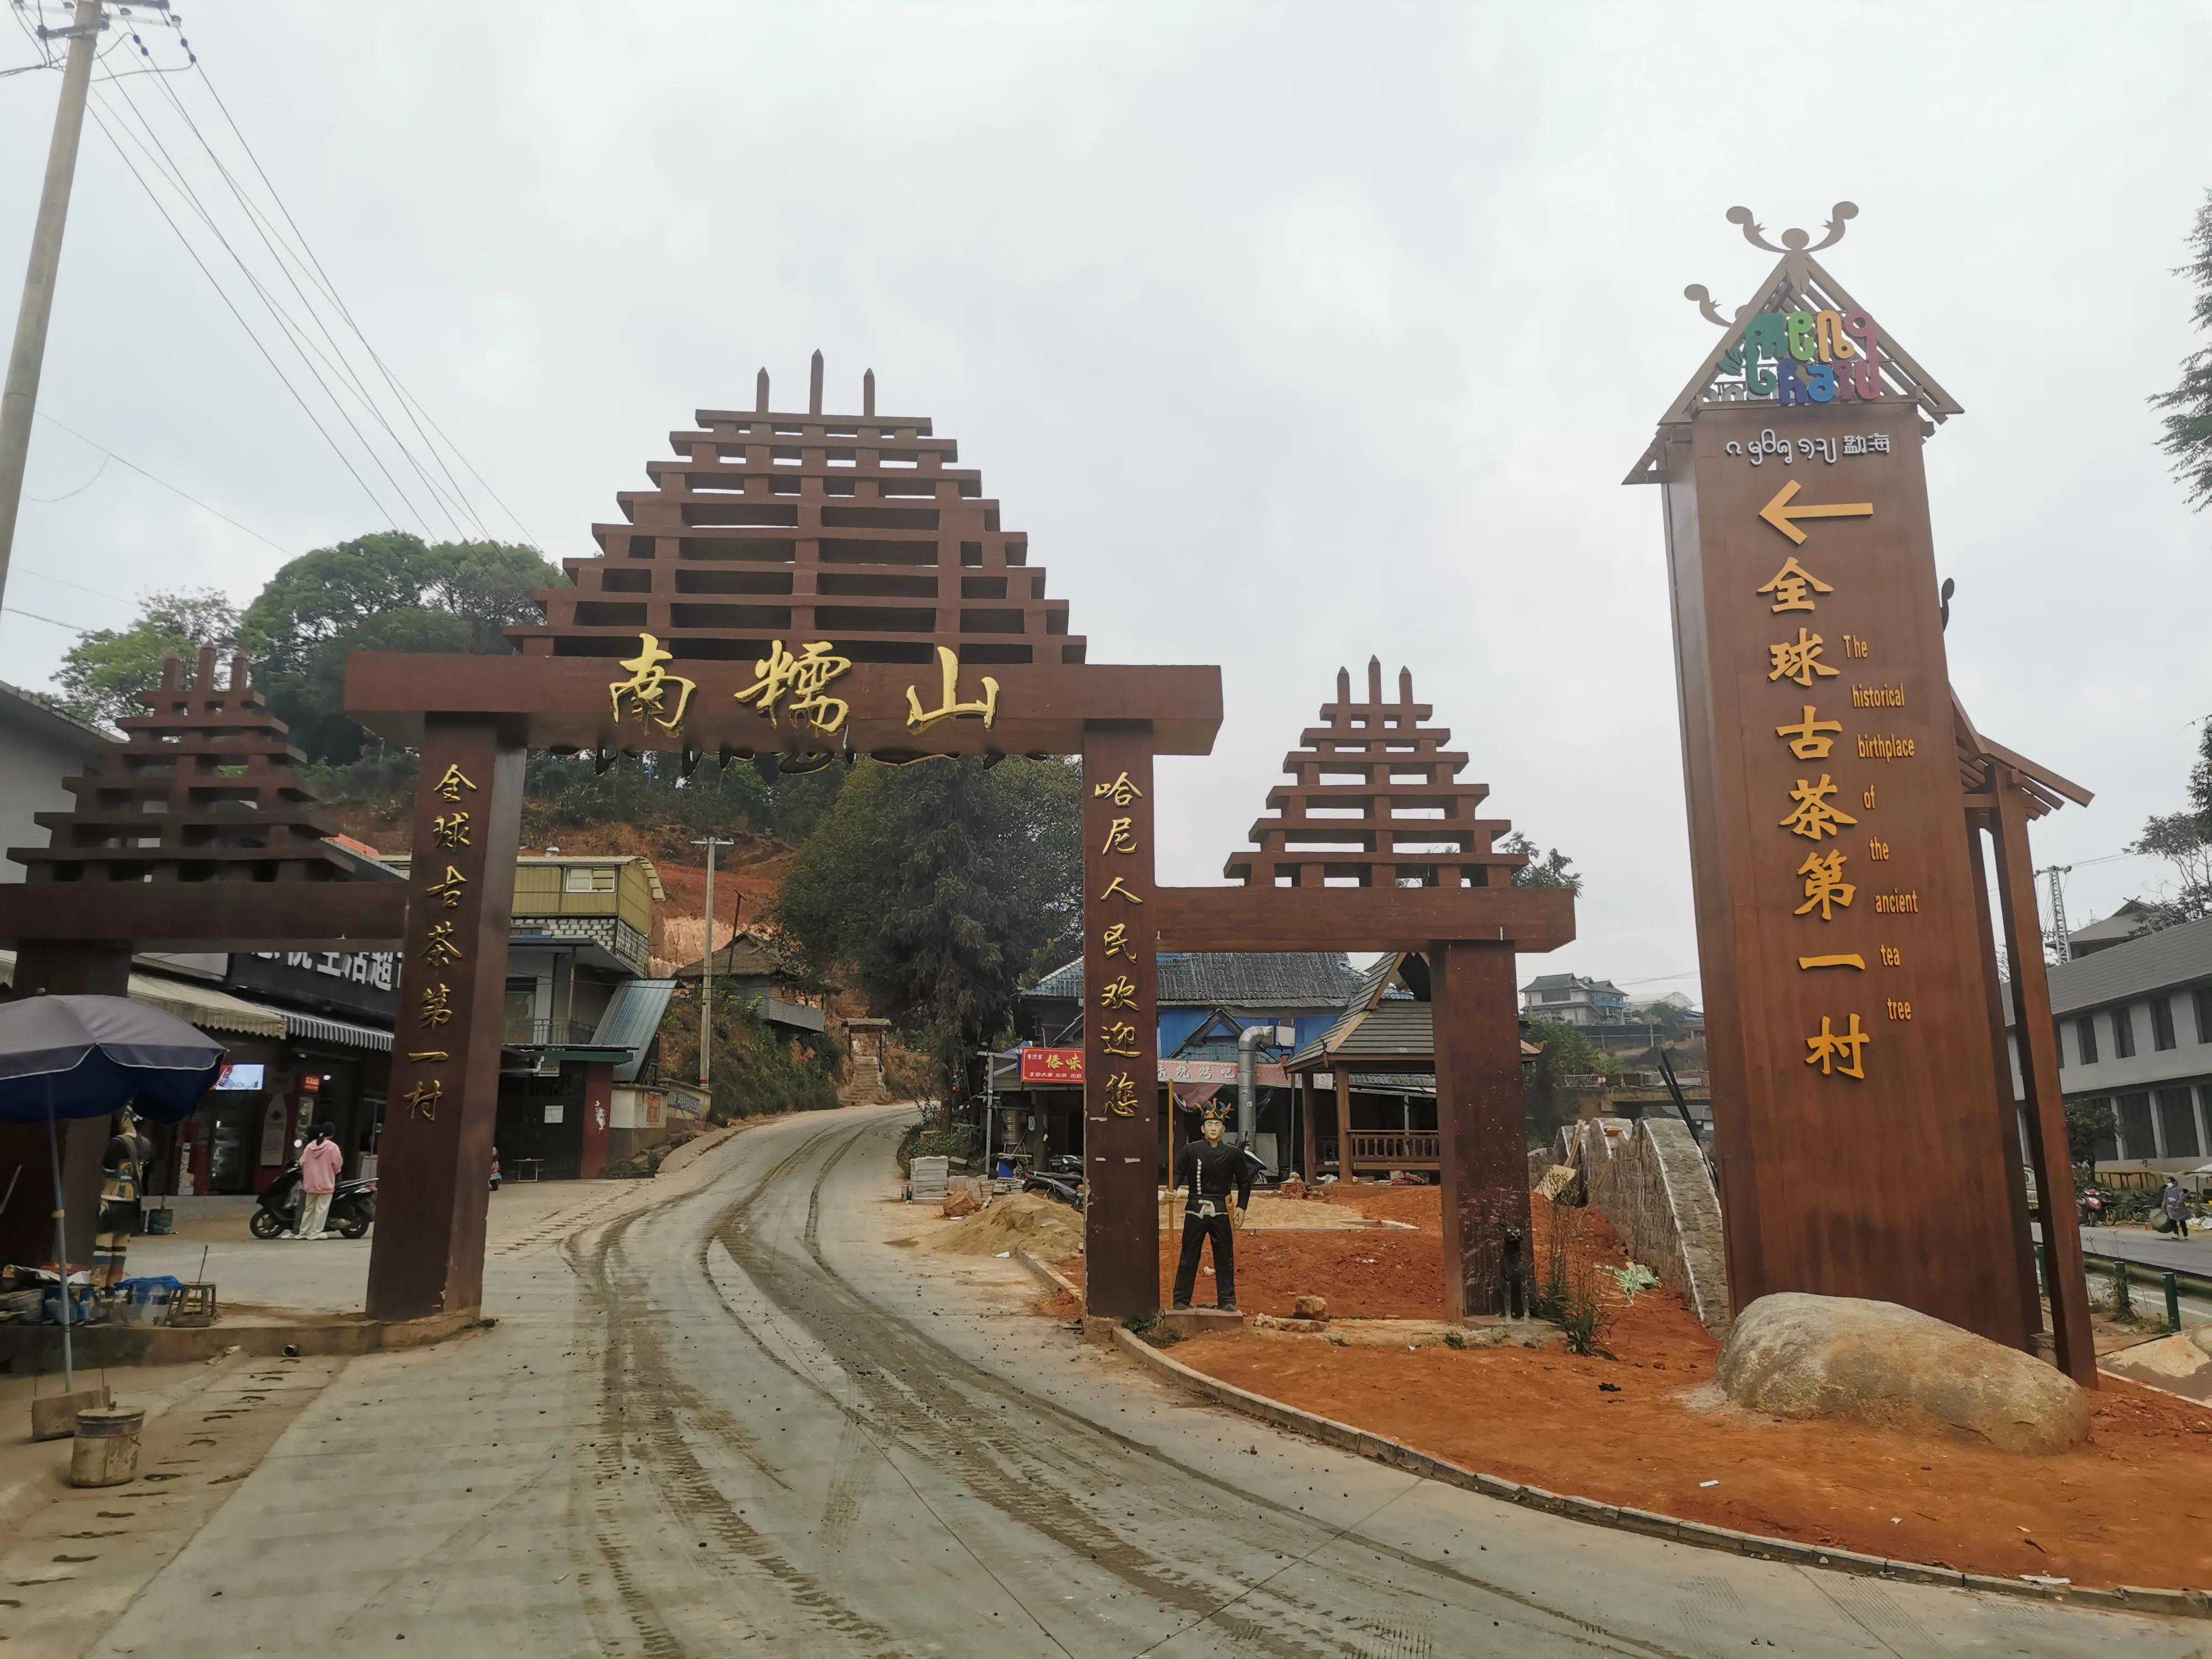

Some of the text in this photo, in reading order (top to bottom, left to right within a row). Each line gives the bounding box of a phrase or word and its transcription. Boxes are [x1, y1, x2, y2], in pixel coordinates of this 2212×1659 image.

[1843, 432, 1891, 456] 勐海
[1843, 634, 1868, 659] The
[609, 633, 1000, 738] 南糯山
[1851, 683, 1905, 708] historical
[1858, 733, 1916, 763] birthplace
[1863, 784, 1876, 809] of
[1756, 556, 1870, 1079] 全球古茶第一村
[1869, 836, 1890, 860] the
[1875, 888, 1919, 914] ancient
[403, 763, 477, 1123] 全球古茶第一村
[1090, 771, 1143, 1118] 哈尼人民欢迎您
[1880, 943, 1900, 967] tea
[1887, 998, 1912, 1020] tree
